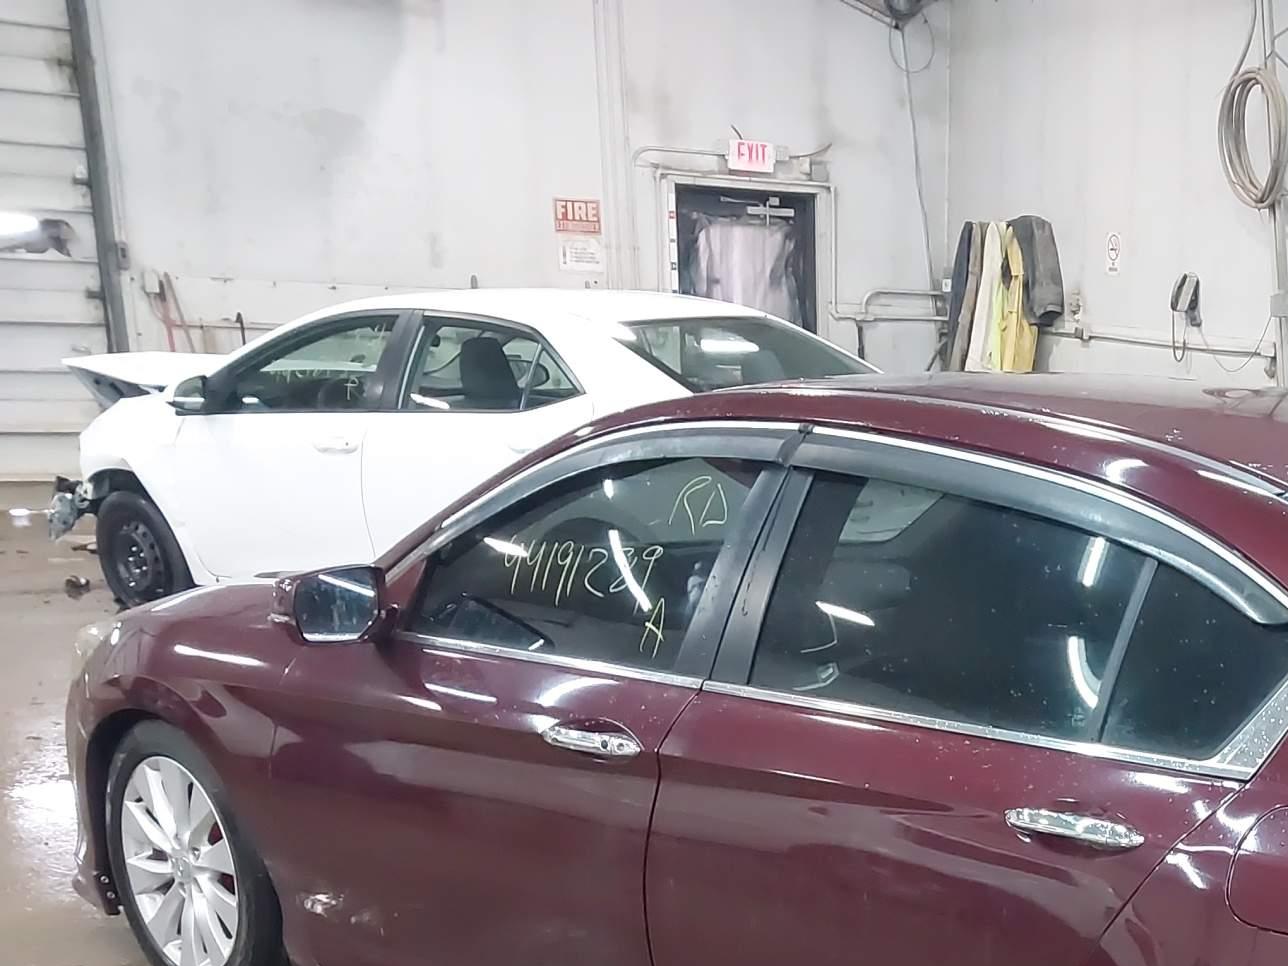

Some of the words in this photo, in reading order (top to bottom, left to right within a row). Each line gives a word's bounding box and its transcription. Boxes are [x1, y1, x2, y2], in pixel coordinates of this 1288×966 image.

[737, 141, 768, 165] EXIT
[555, 200, 599, 221] FIRE
[503, 534, 664, 616] 44191289
